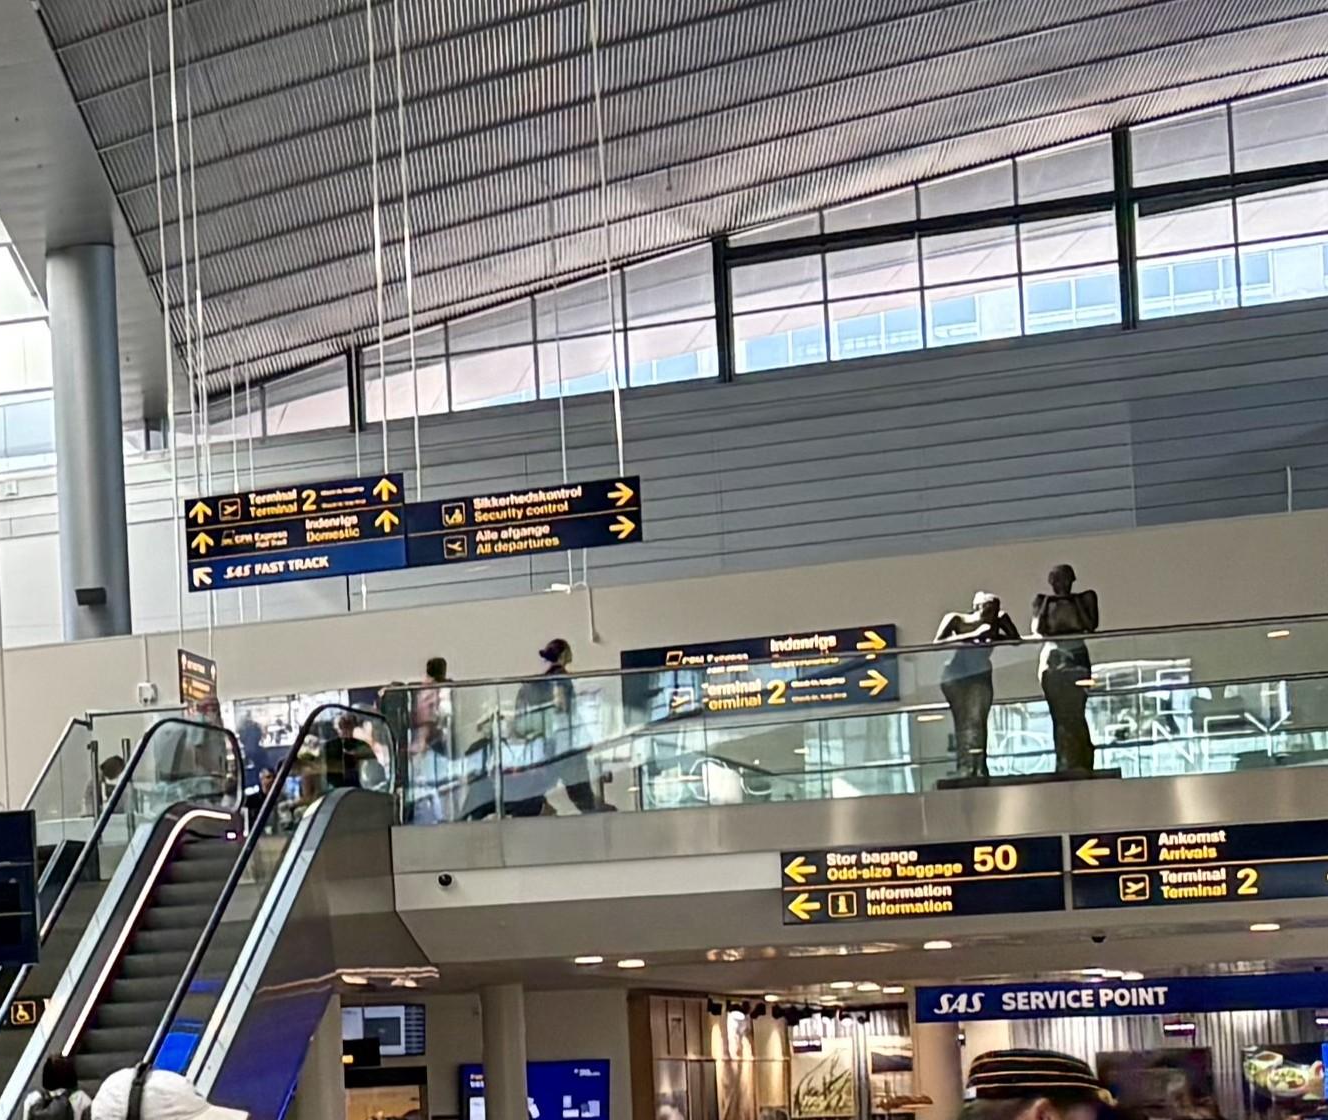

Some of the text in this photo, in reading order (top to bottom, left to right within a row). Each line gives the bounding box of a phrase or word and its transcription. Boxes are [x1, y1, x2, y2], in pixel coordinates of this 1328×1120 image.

[249, 488, 298, 506] Terminal
[302, 489, 317, 511] 2
[473, 485, 582, 511] Sikkerhedskontrol
[250, 502, 298, 519] Terminal
[474, 501, 569, 523] Security control
[305, 514, 358, 530] Indenrigs
[306, 527, 360, 543] Domestic
[476, 524, 550, 542] Alle afgange
[476, 535, 560, 555] All departures
[223, 556, 329, 579] SAS FAST TRACK
[767, 679, 786, 705] 2
[1158, 830, 1226, 846] Ankomst
[826, 844, 1018, 873] Stor bagage 50
[1159, 845, 1217, 861] Arrivals
[827, 861, 963, 881] Odd-size baggage
[1160, 867, 1258, 895] Terminal 2
[866, 885, 952, 900] Information
[1161, 882, 1227, 899] Terminal
[867, 900, 953, 916] Information
[934, 986, 1168, 1014] SAS SERVICE POINT
